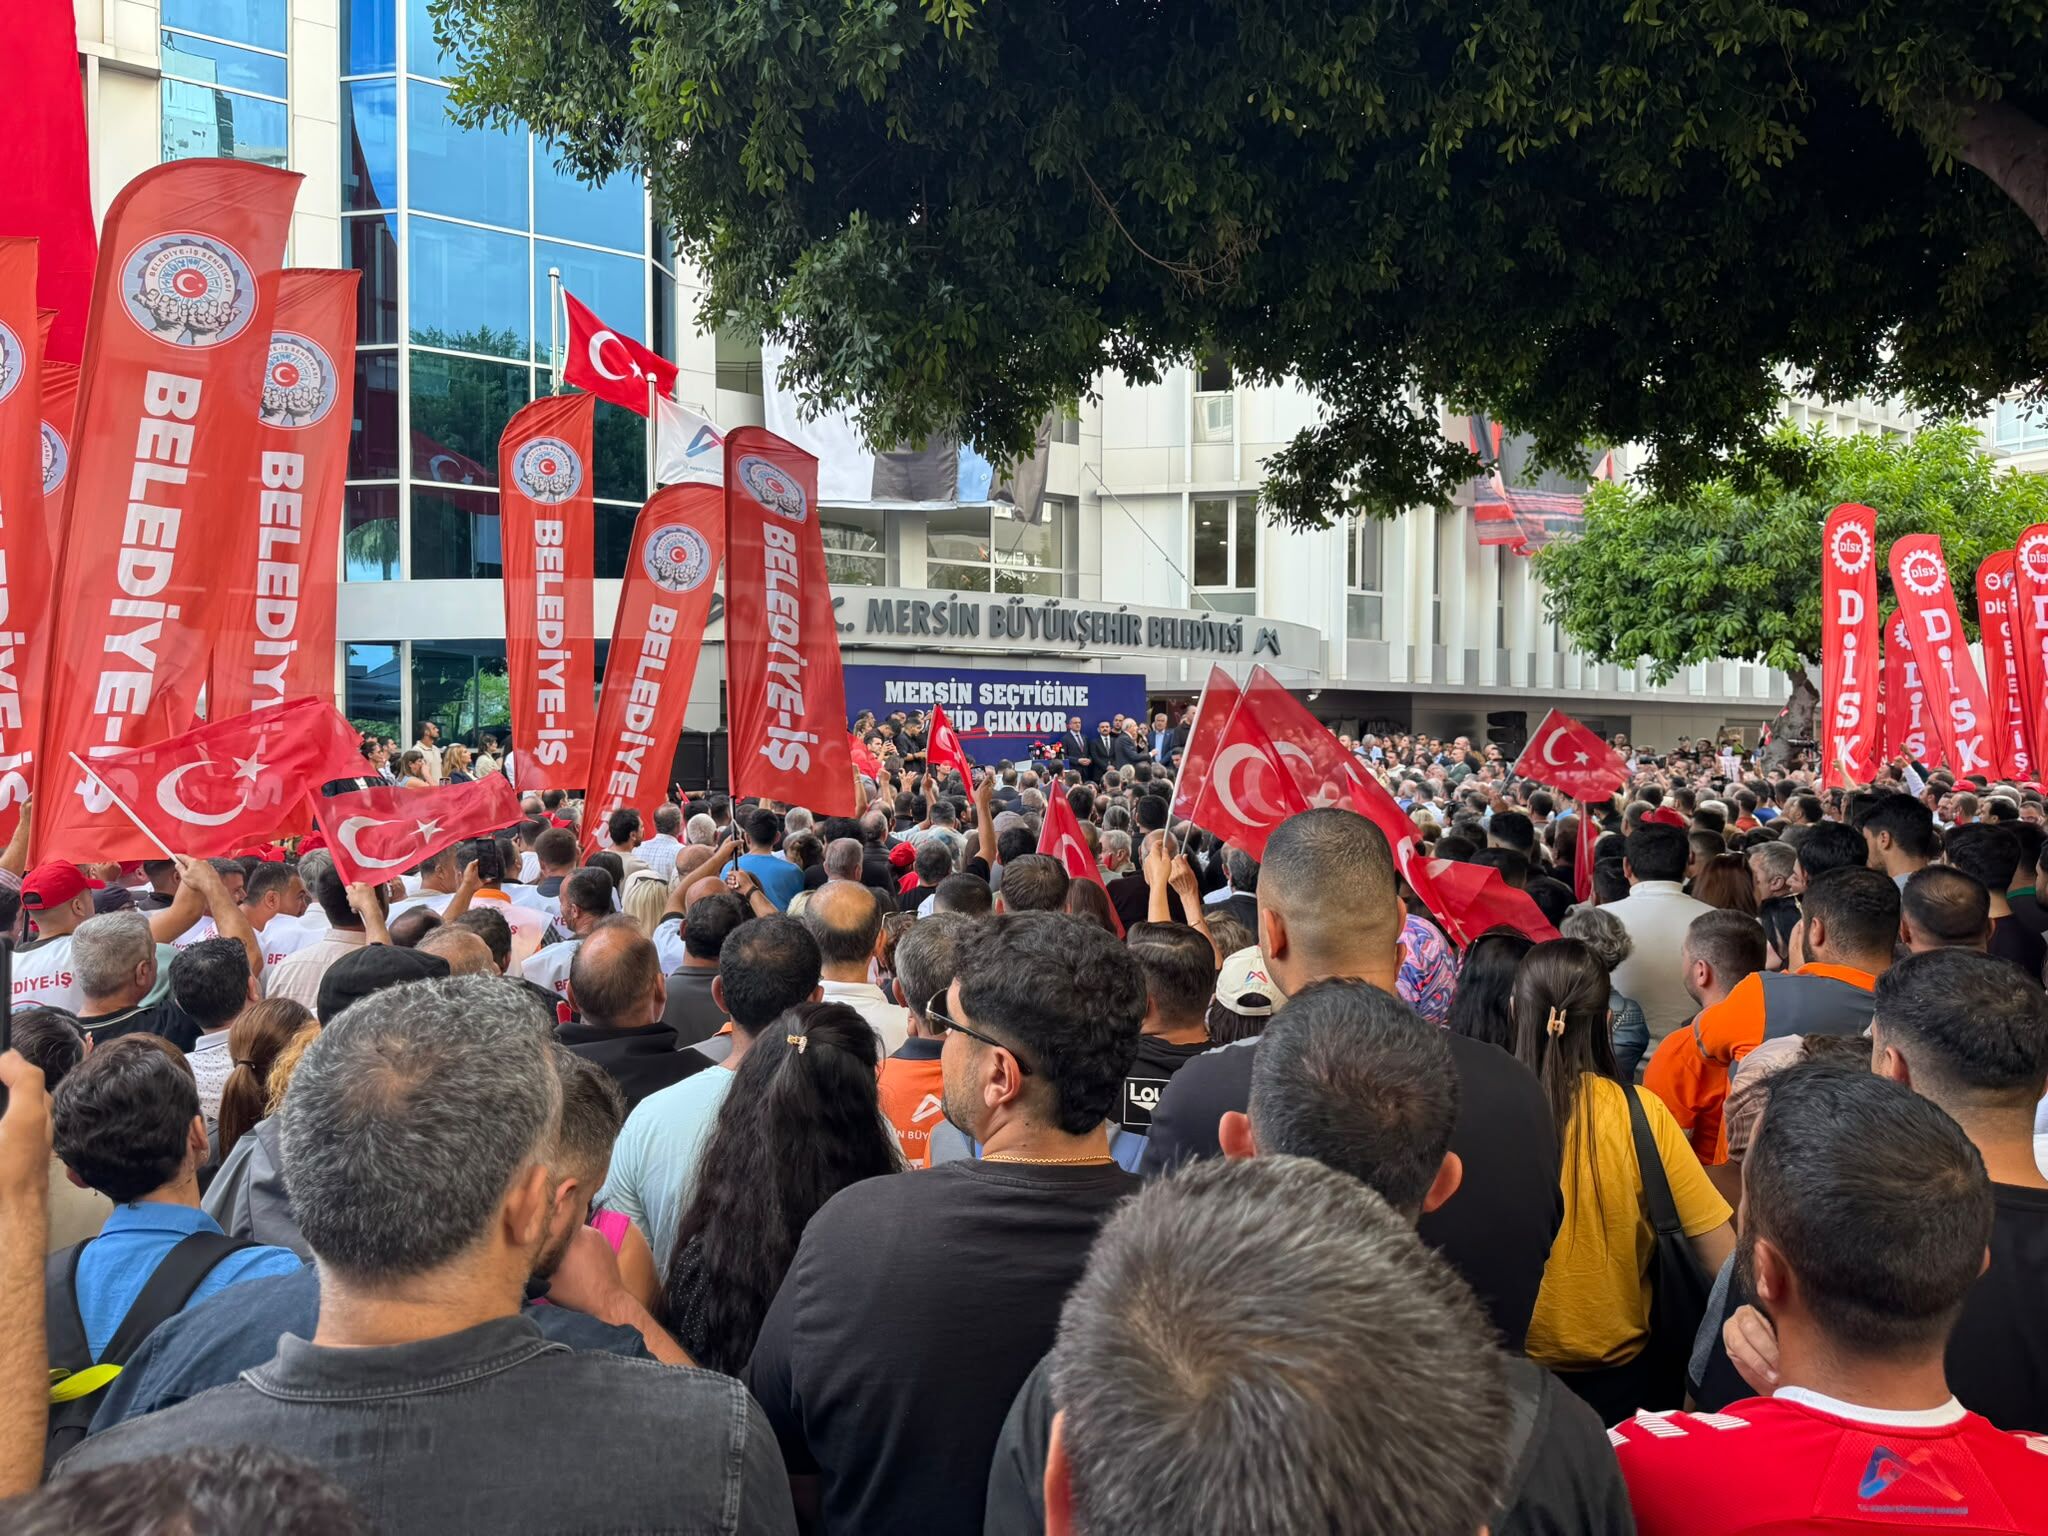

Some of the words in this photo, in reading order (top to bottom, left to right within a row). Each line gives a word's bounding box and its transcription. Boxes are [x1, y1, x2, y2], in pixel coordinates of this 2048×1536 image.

[200, 251, 232, 293] SENDİKASI
[534, 519, 574, 767] BELEDİYE-İŞ
[759, 521, 819, 774] BELEDİYE-İŞ
[866, 593, 980, 637] MERSİN
[989, 597, 1143, 650] BÜYÜKŞEHİR
[1147, 612, 1244, 653] BELEDİYESİ
[885, 677, 973, 705] MERSİN
[979, 680, 1089, 710] SEÇTİĞİNE
[1920, 608, 1990, 772] DİSK
[984, 711, 1068, 737] ÇIKIYOR
[11, 970, 73, 994] DİYE-İŞ
